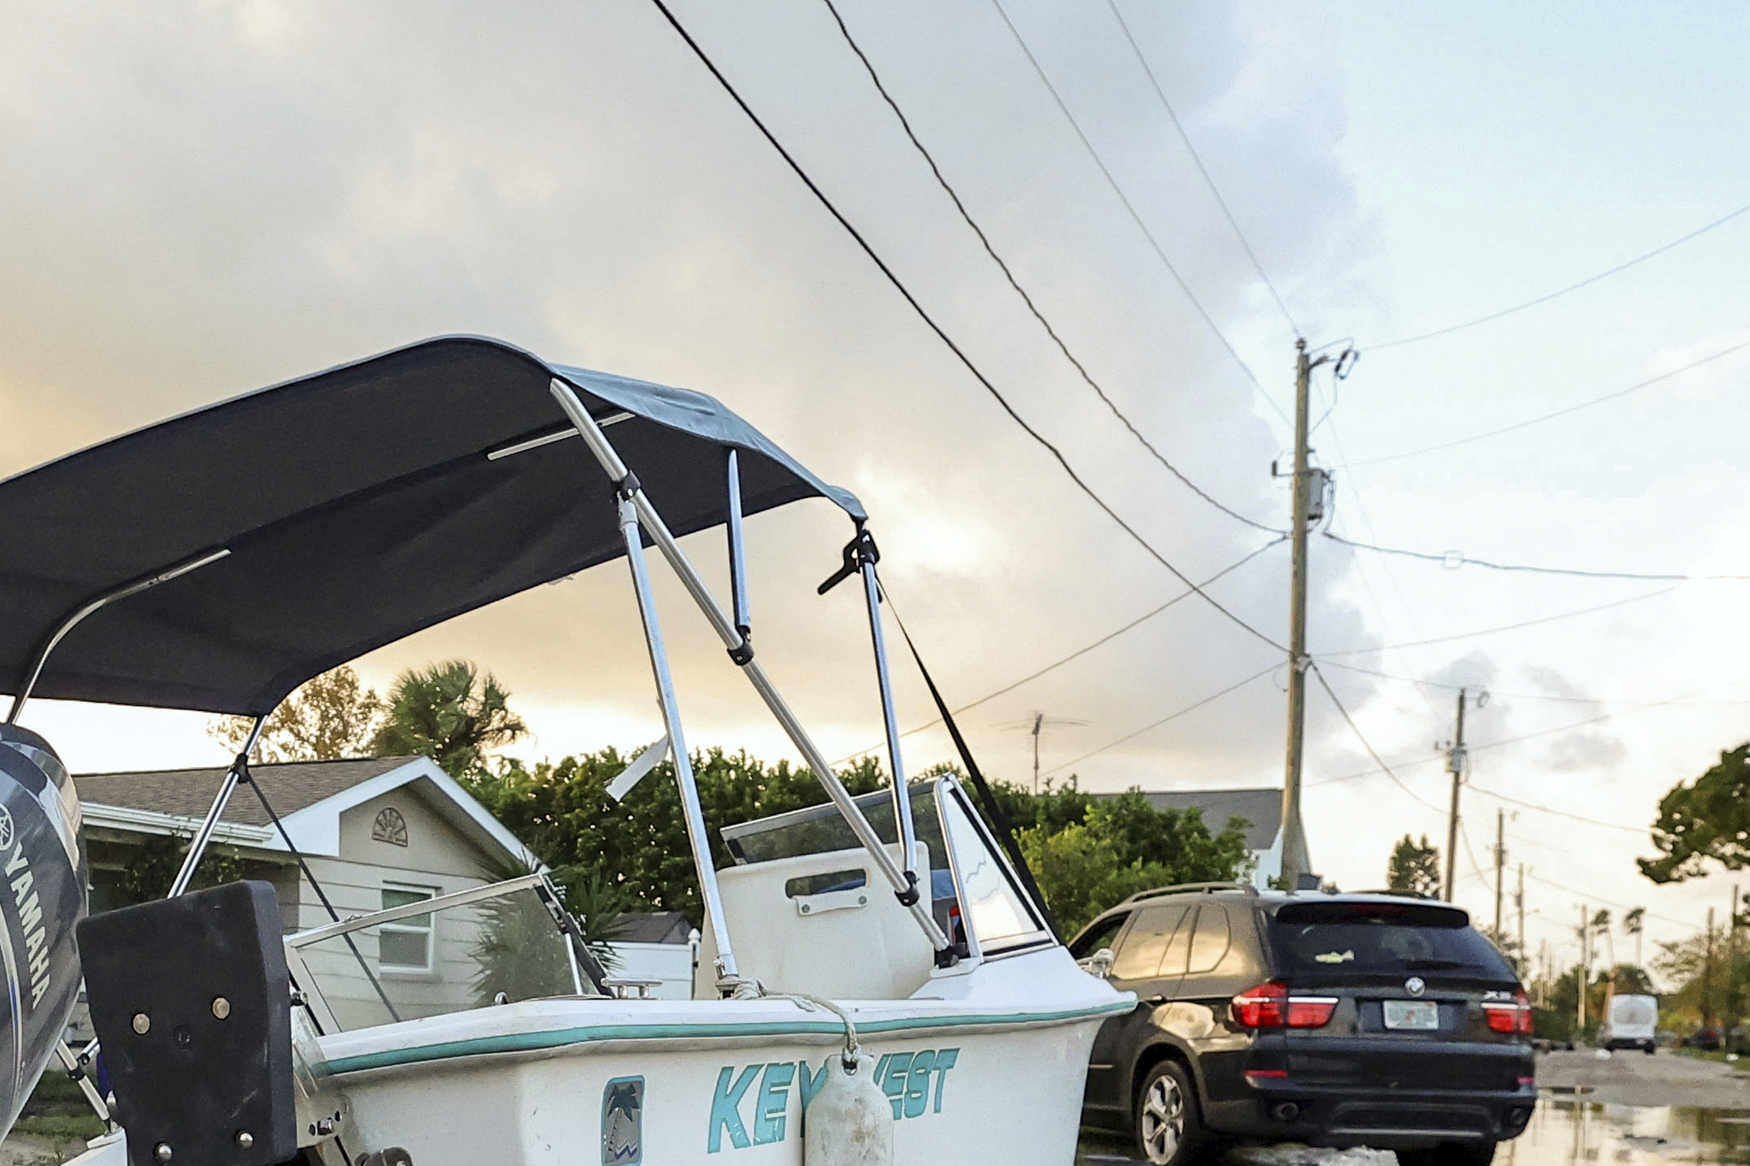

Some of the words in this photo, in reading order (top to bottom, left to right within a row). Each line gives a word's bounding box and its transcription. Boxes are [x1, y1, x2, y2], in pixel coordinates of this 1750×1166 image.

[4, 840, 51, 1010] YAMAHA
[707, 1061, 828, 1154] KEY
[873, 1047, 961, 1121] EST
